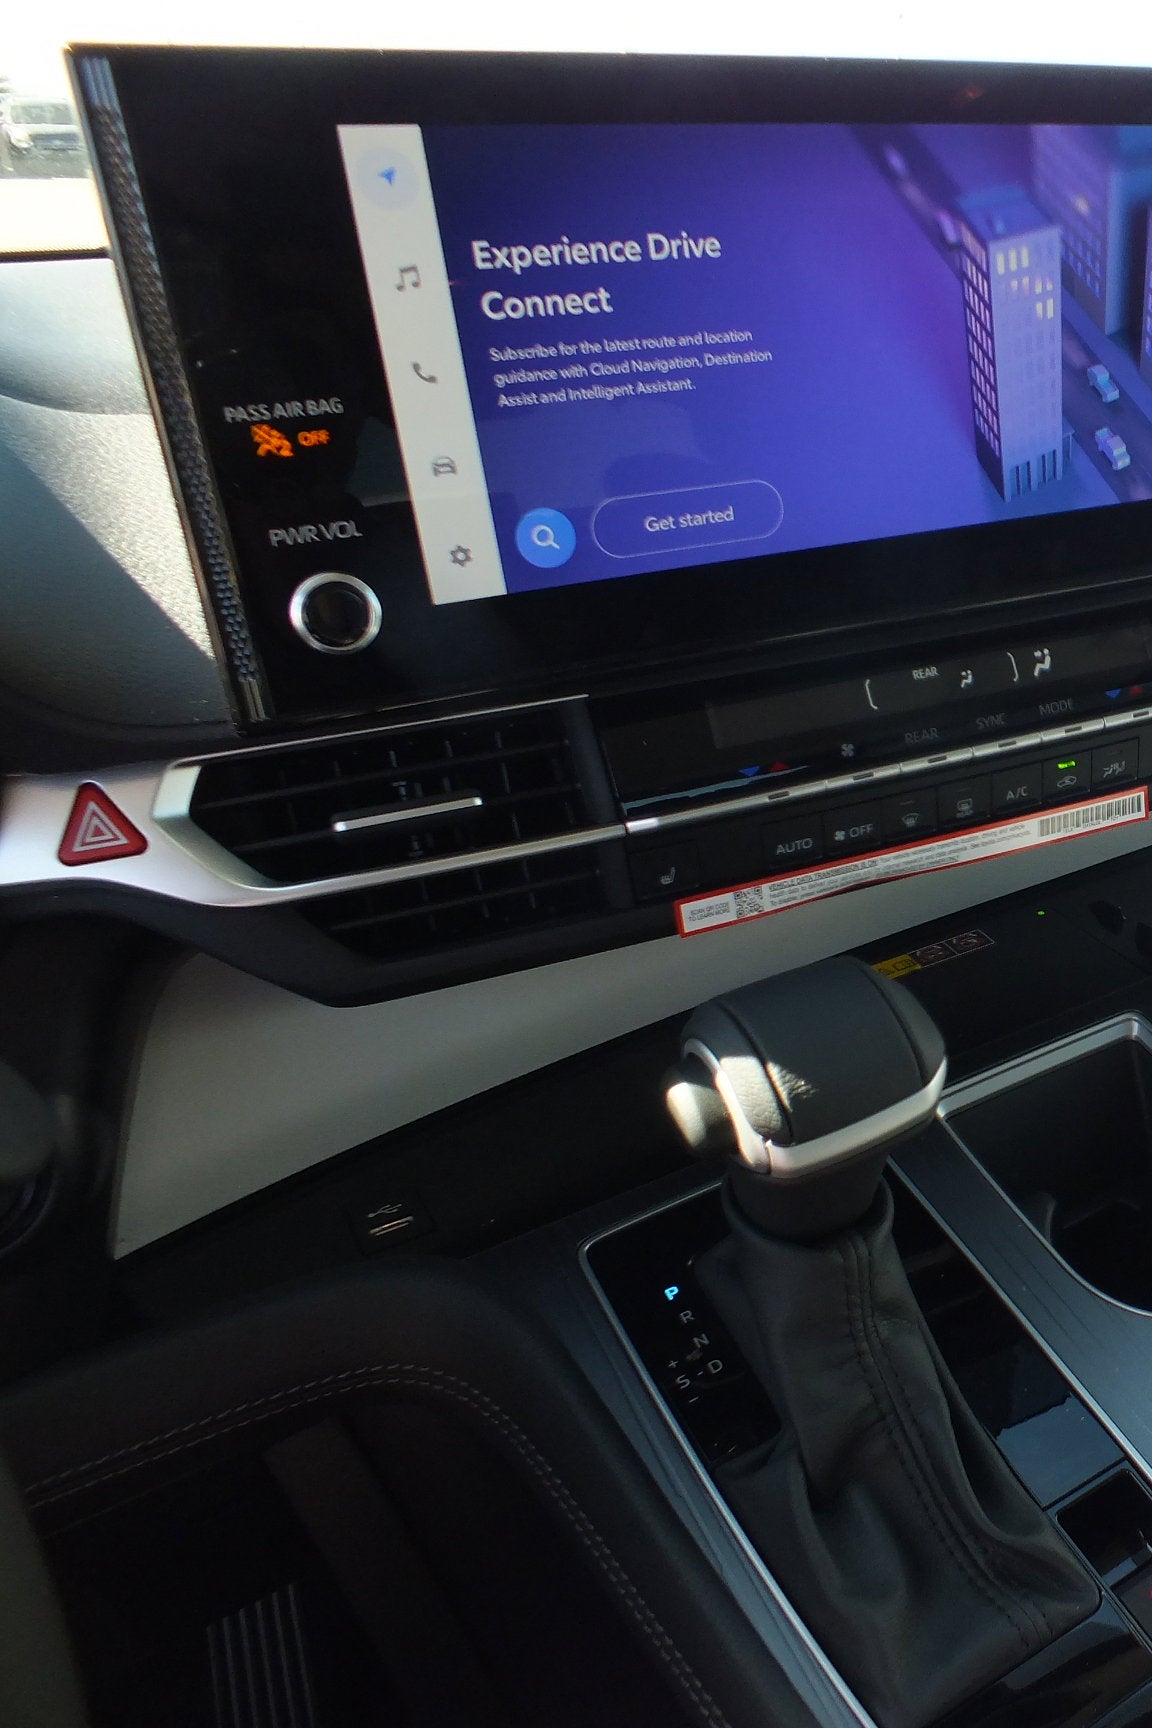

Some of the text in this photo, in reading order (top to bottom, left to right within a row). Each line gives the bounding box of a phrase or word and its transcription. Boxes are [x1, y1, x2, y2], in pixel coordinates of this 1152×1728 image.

[471, 231, 722, 275] Experience Drive
[480, 287, 614, 321] Connect
[489, 329, 753, 362] Subscribe for the latest route and location
[493, 350, 773, 388] guidance with Cloud Navigation, Destination
[497, 377, 697, 408] Assist and Intelligent Assistant.
[223, 397, 344, 423] PASS AIR BAG
[297, 429, 331, 447] OFF
[644, 506, 736, 532] Get started
[268, 519, 363, 547] PWR VOL
[912, 666, 939, 681] REAR
[903, 727, 939, 745] REAR
[1006, 785, 1029, 800] A/C
[849, 823, 875, 838] OFF
[775, 837, 813, 856] AUTO
[664, 1286, 679, 1301] P
[679, 1310, 696, 1324] R
[692, 1333, 710, 1348] N
[707, 1359, 723, 1374] D
[675, 1374, 691, 1390] S
